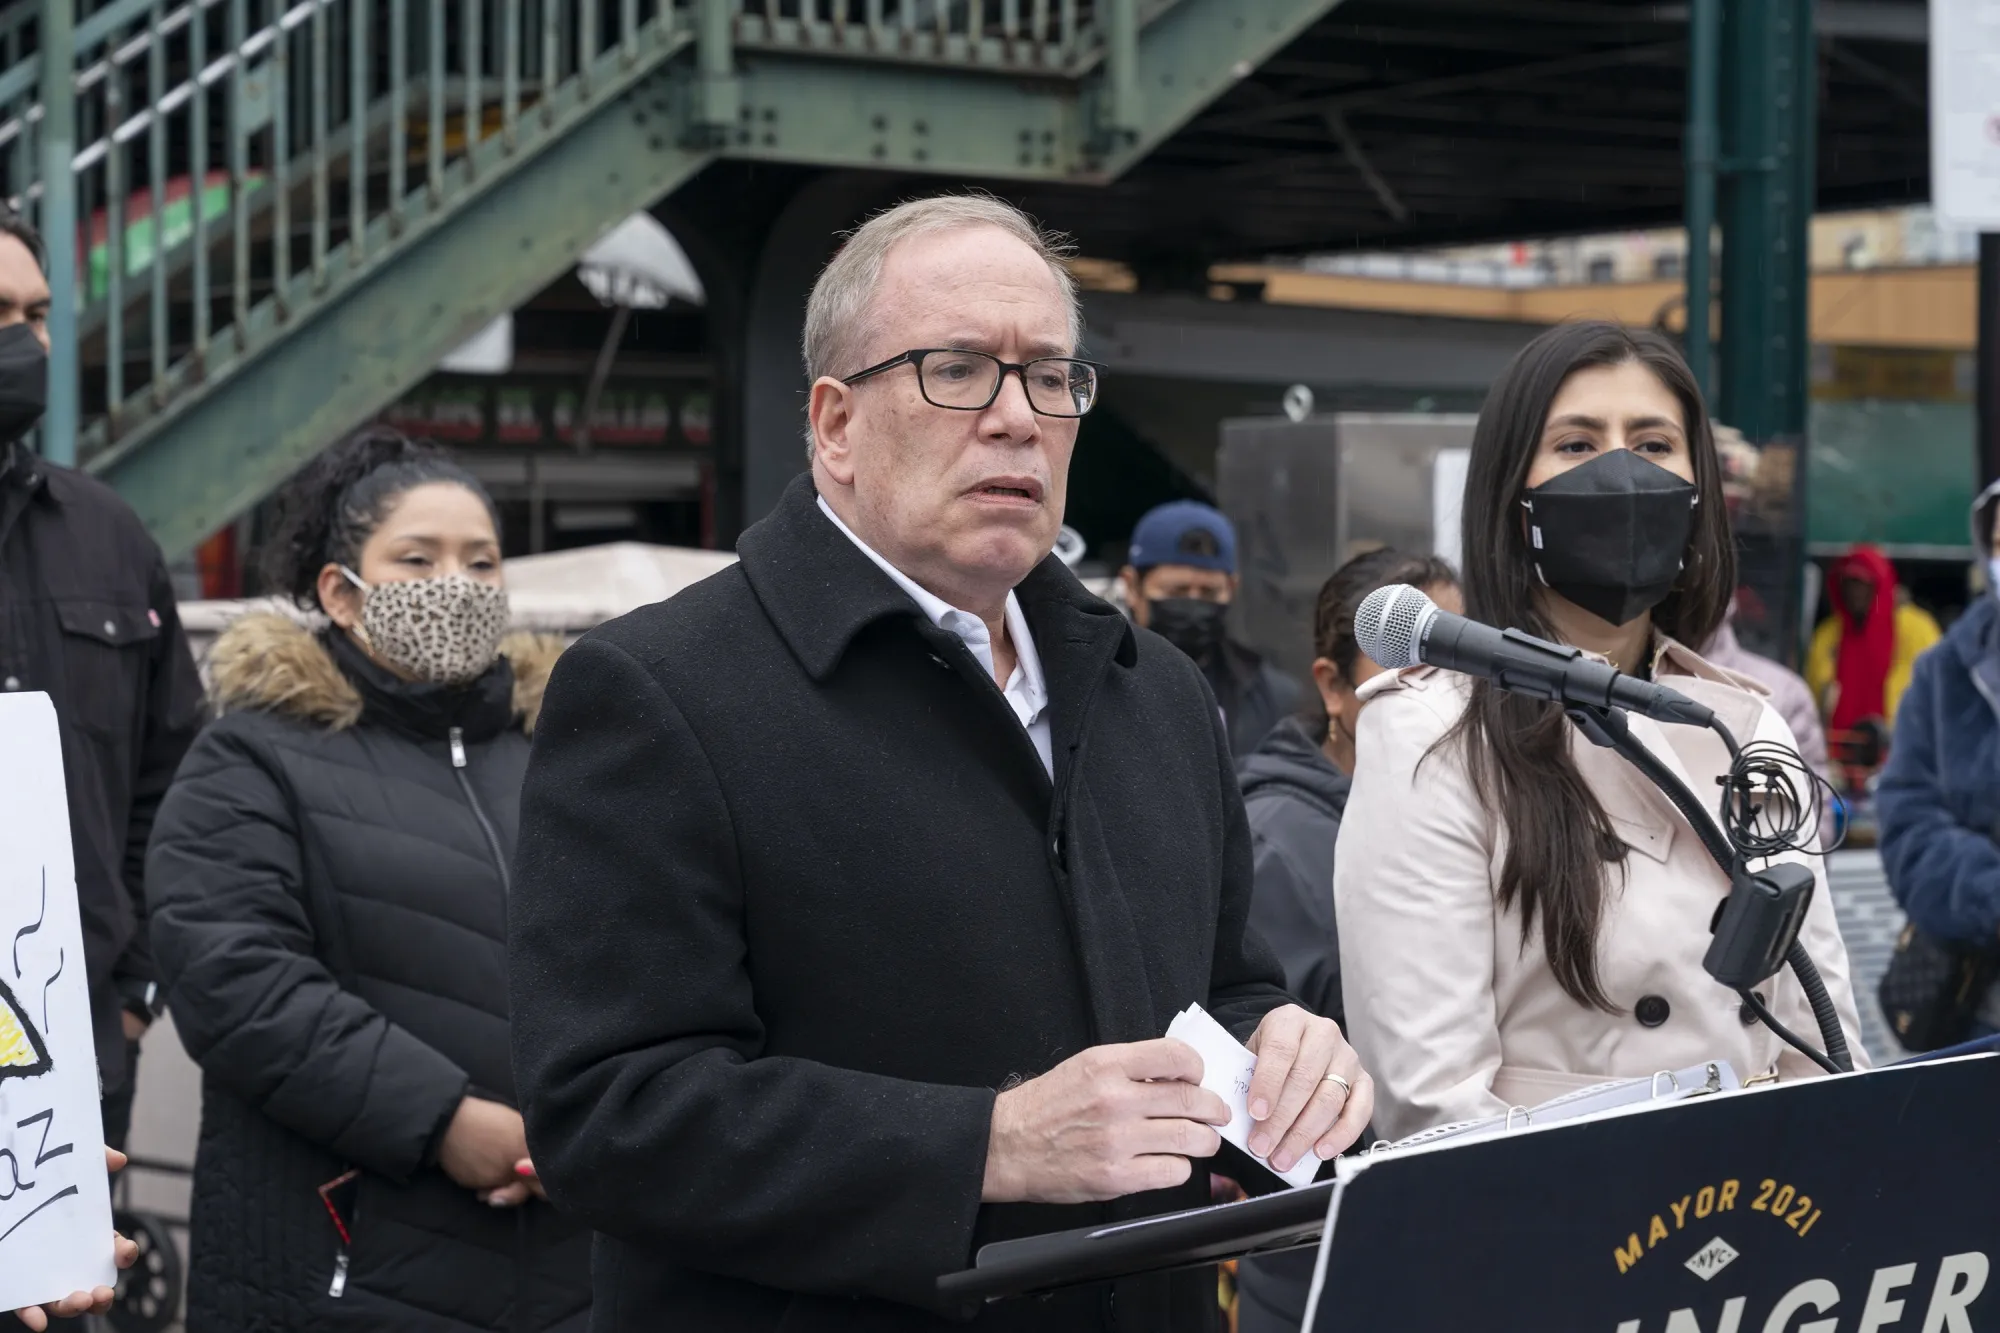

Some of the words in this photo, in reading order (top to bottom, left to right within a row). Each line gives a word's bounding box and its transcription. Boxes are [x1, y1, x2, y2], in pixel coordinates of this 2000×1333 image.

[1614, 1179, 1740, 1274] MAYOR
[1751, 1178, 1822, 1237] 2021
[1615, 1251, 1990, 1333] GER
